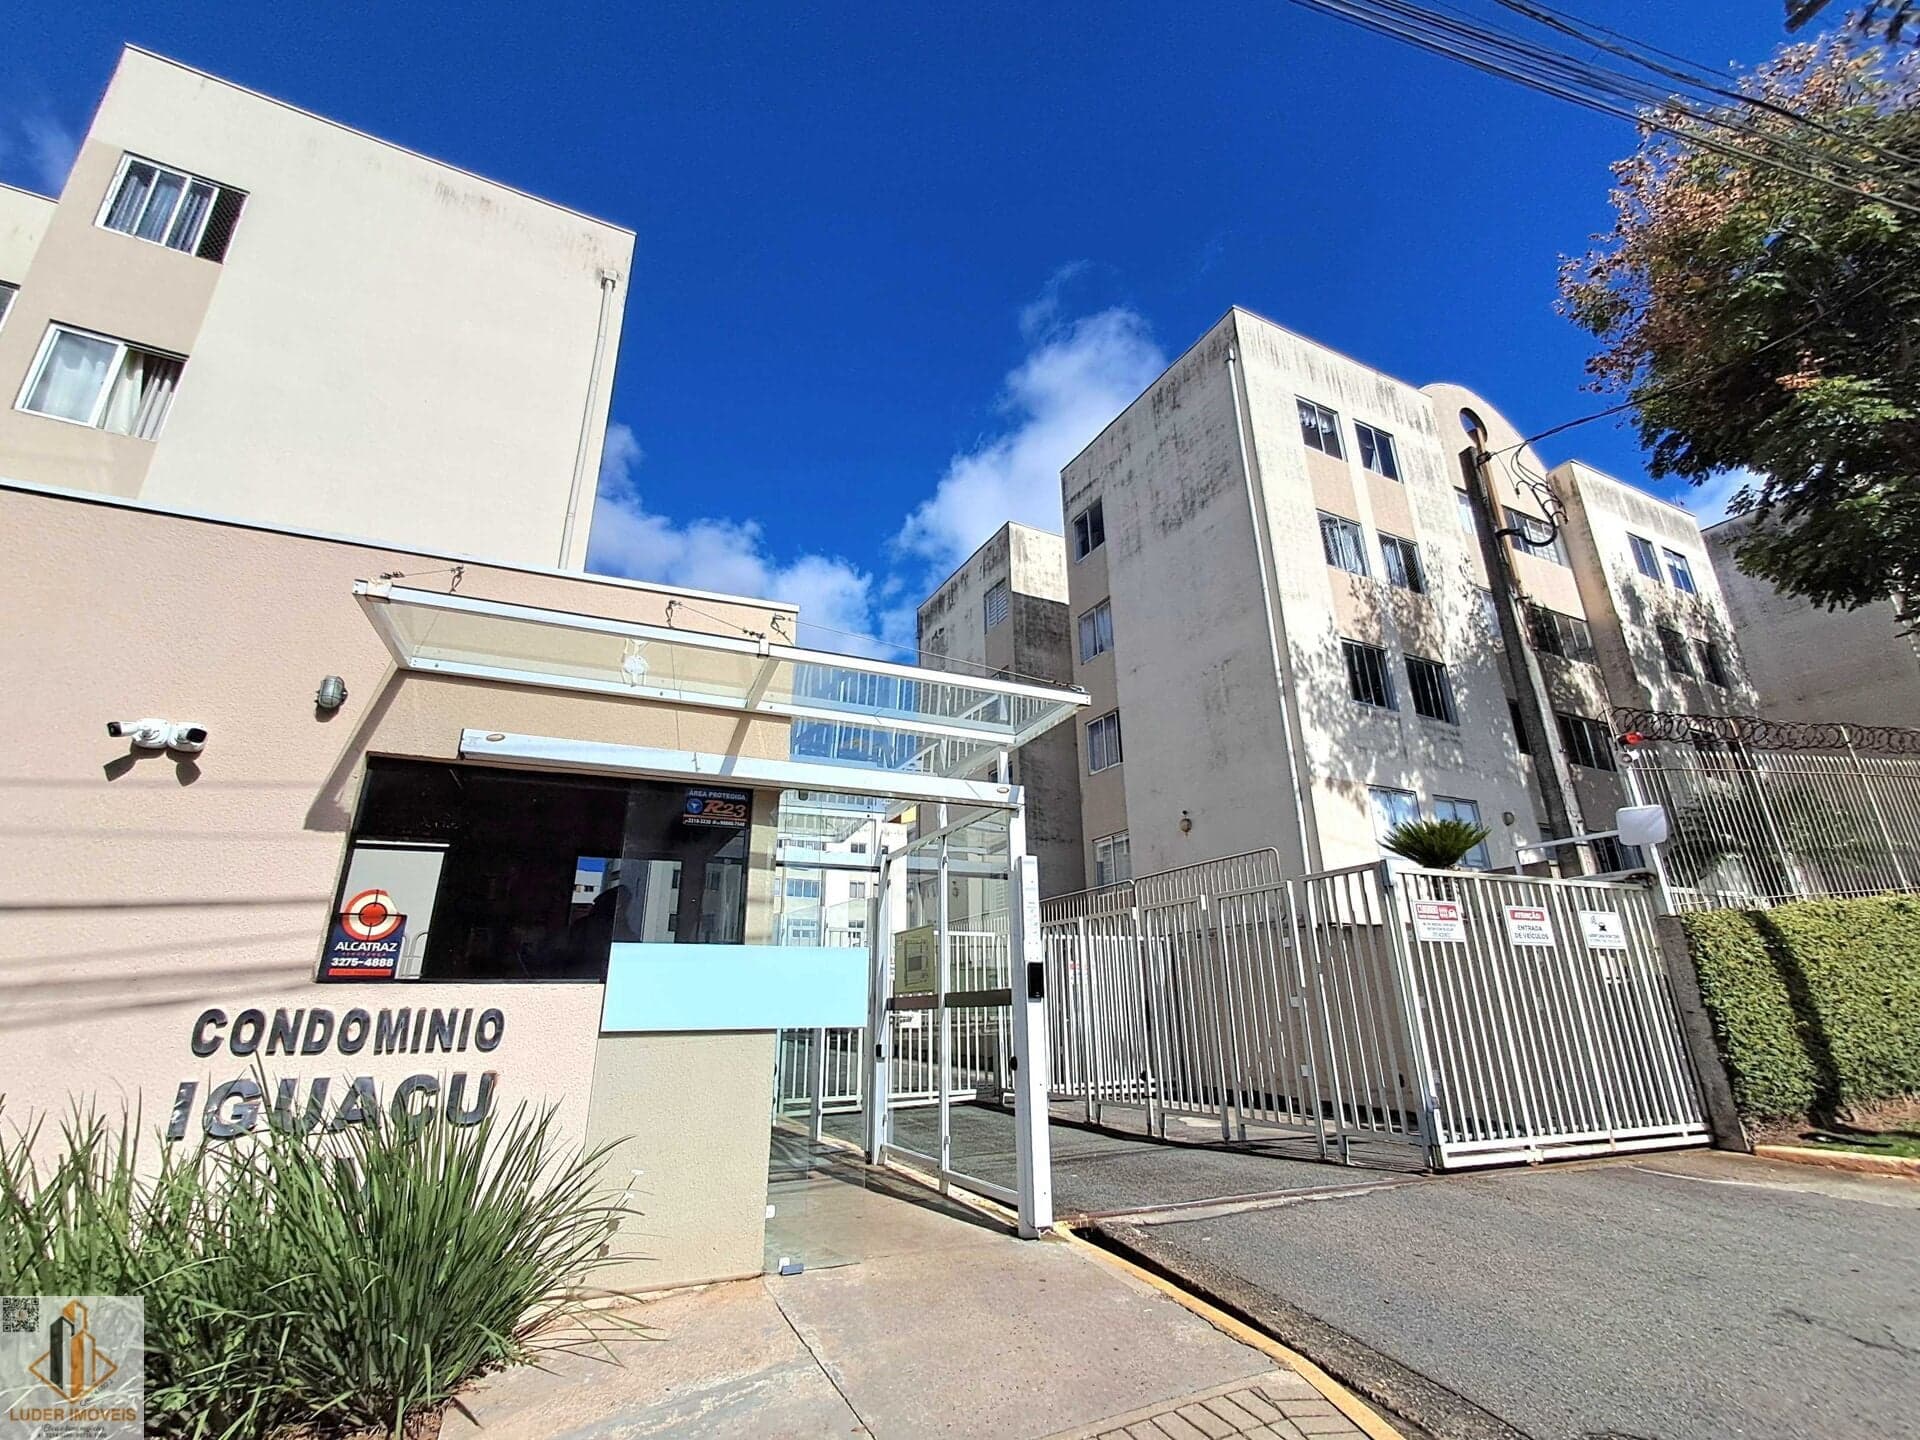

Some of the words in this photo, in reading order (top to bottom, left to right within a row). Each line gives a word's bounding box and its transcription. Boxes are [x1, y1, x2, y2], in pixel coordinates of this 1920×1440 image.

[708, 791, 746, 800] PROTEGIDA
[703, 800, 747, 818] R23
[334, 941, 398, 952] ALCATRAZ
[331, 957, 394, 967] 3275-4888
[191, 1007, 505, 1058] CONDOMINIO
